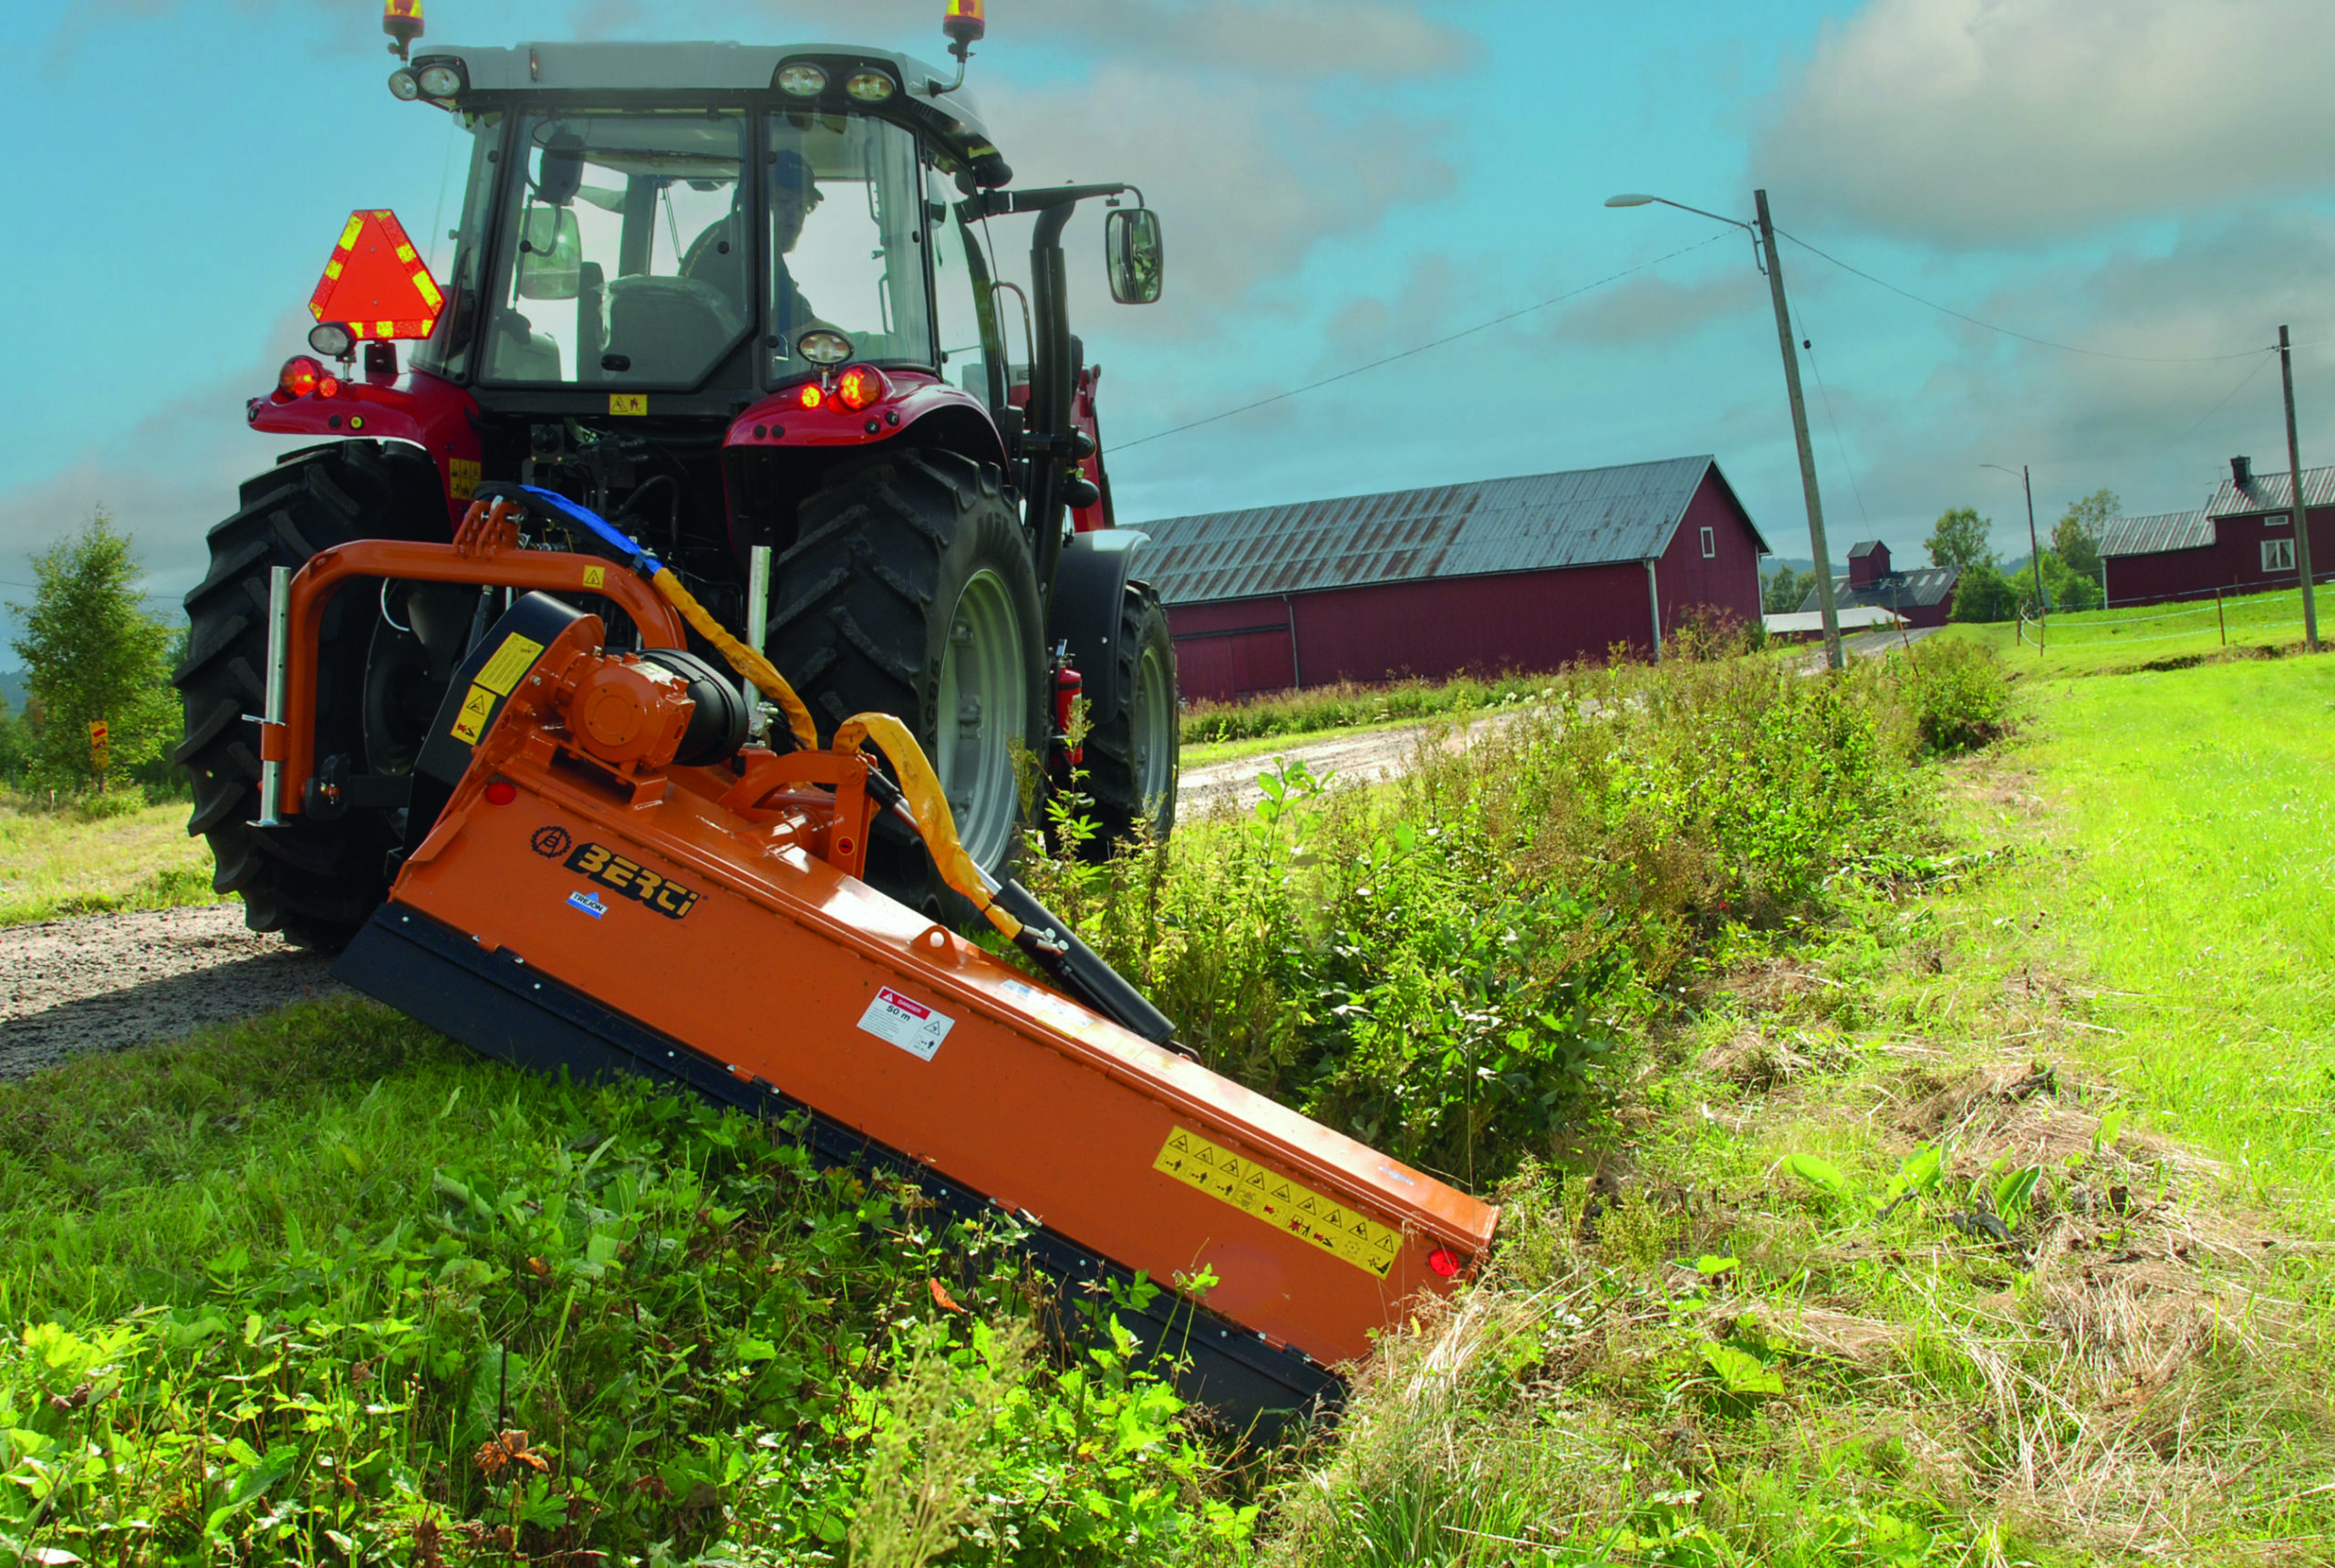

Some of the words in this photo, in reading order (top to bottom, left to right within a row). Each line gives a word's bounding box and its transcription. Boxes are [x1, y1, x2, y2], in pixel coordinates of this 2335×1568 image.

[573, 893, 604, 912] TREJON
[886, 1005, 900, 1015] 50
[900, 1013, 911, 1022] m
[897, 998, 922, 1014] DANGER
